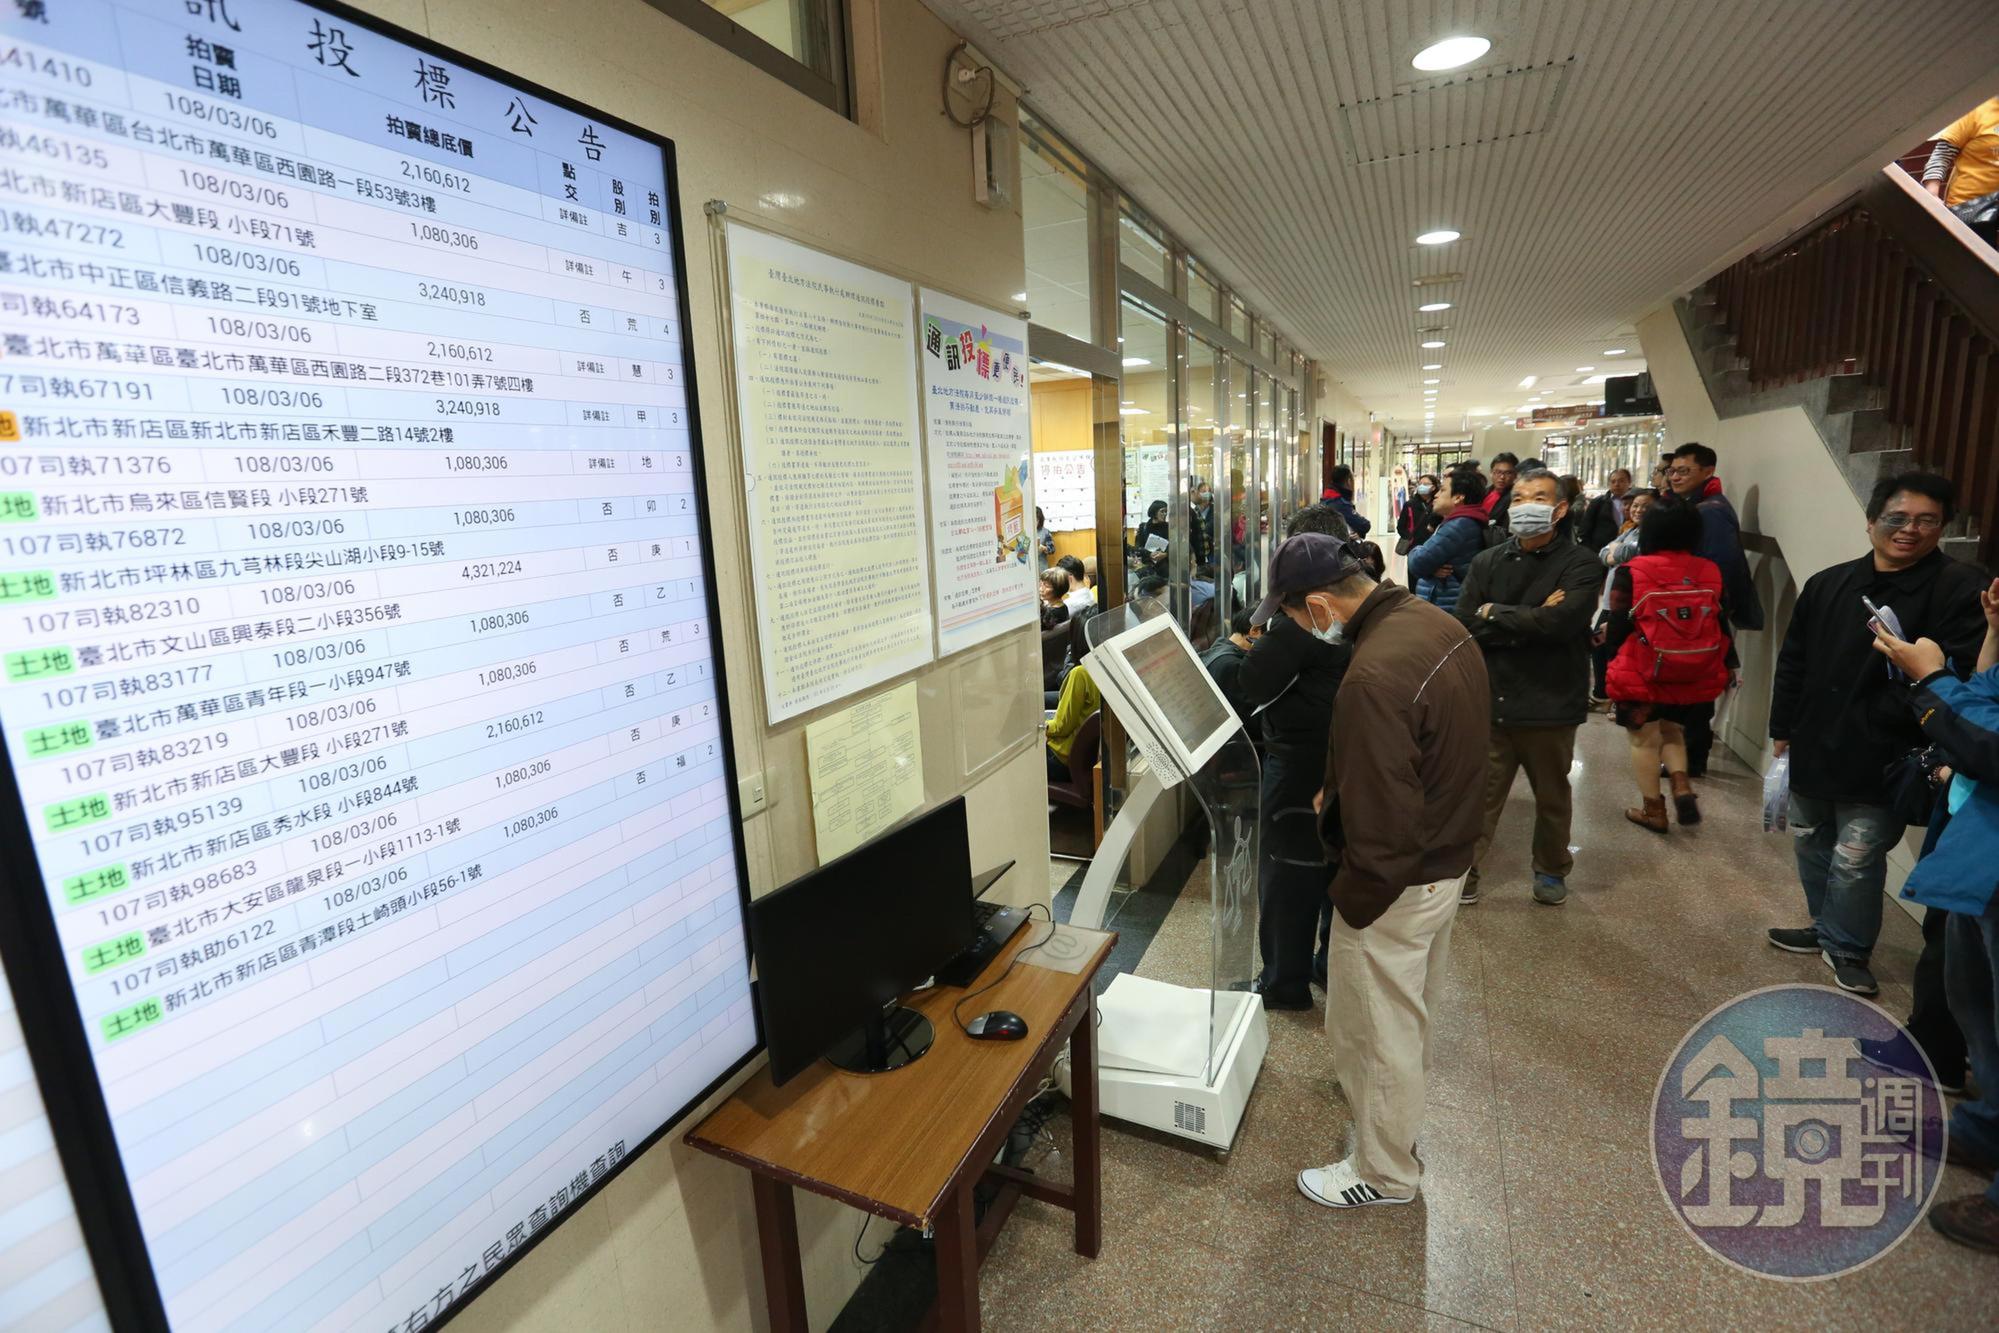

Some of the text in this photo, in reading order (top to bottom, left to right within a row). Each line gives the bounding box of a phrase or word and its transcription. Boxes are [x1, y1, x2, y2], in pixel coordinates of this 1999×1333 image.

[186, 34, 236, 71] 拍賣
[192, 64, 243, 99] 日期
[386, 113, 475, 159] 拍賣總底價
[164, 92, 278, 139] 108/03/06
[400, 160, 471, 193] 2,160,612
[616, 222, 628, 237] 吉
[654, 234, 661, 245] 3
[179, 168, 289, 209] 108/03/06
[410, 223, 479, 250] 1,080,306
[621, 270, 632, 284] 午
[658, 279, 665, 290] 3
[648, 191, 662, 226] 拍別
[194, 244, 300, 284] 108/03/06
[418, 282, 486, 307] 3,240,918
[579, 309, 591, 324] 否
[663, 325, 669, 336] 4
[207, 316, 312, 343] 108/03/06
[427, 341, 494, 363] 2,160,612
[667, 369, 673, 380] 3
[221, 387, 322, 408] 108/03/06
[436, 400, 500, 416] 3,240,918
[637, 410, 646, 422] 甲
[672, 413, 678, 423] 3
[234, 456, 334, 473] 108/03/06
[445, 457, 508, 470] 1,080,306
[641, 457, 652, 468] 地
[676, 457, 682, 467] 3
[0, 496, 34, 518] 地
[4, 527, 186, 556] 107司執76872
[249, 518, 344, 540] 108/03/06
[454, 509, 515, 526] 1,080,306
[602, 502, 612, 516] 否
[681, 499, 687, 510] 2
[23, 597, 200, 634] 107司執82310
[260, 579, 355, 605] 108/03/06
[462, 560, 522, 579] 4,321,224
[607, 548, 618, 562] 否
[686, 541, 690, 551] 1
[12, 650, 71, 679] 土地
[41, 582, 694, 710] 107司執83177 108/03/06 1,080,306 否 乙 1
[61, 731, 229, 785] 107司執83219
[285, 698, 376, 732] 108/03/06
[479, 661, 537, 686] 1,080,306
[619, 639, 629, 653] 否
[694, 624, 700, 635] 3
[31, 725, 90, 753] 土地
[80, 665, 703, 857] 107司執95139 108/03/06 2,160,612 否 乙 1
[51, 797, 109, 829] 土地
[99, 861, 257, 926] 107司執98683
[311, 812, 397, 853] 108/03/06
[495, 760, 551, 789] 1,080,306
[631, 728, 641, 742] 否
[703, 705, 709, 716] 2
[69, 869, 126, 900] 土地
[111, 919, 276, 997] 107司執助6122
[323, 866, 408, 911] 108/03/06
[503, 807, 558, 839] 1,080,306
[636, 771, 647, 784] 否
[707, 745, 713, 755] 2
[88, 937, 143, 969] 土地
[108, 1001, 160, 1037] 土地
[388, 1138, 626, 1333] 右方之民眾查詢機查詢
